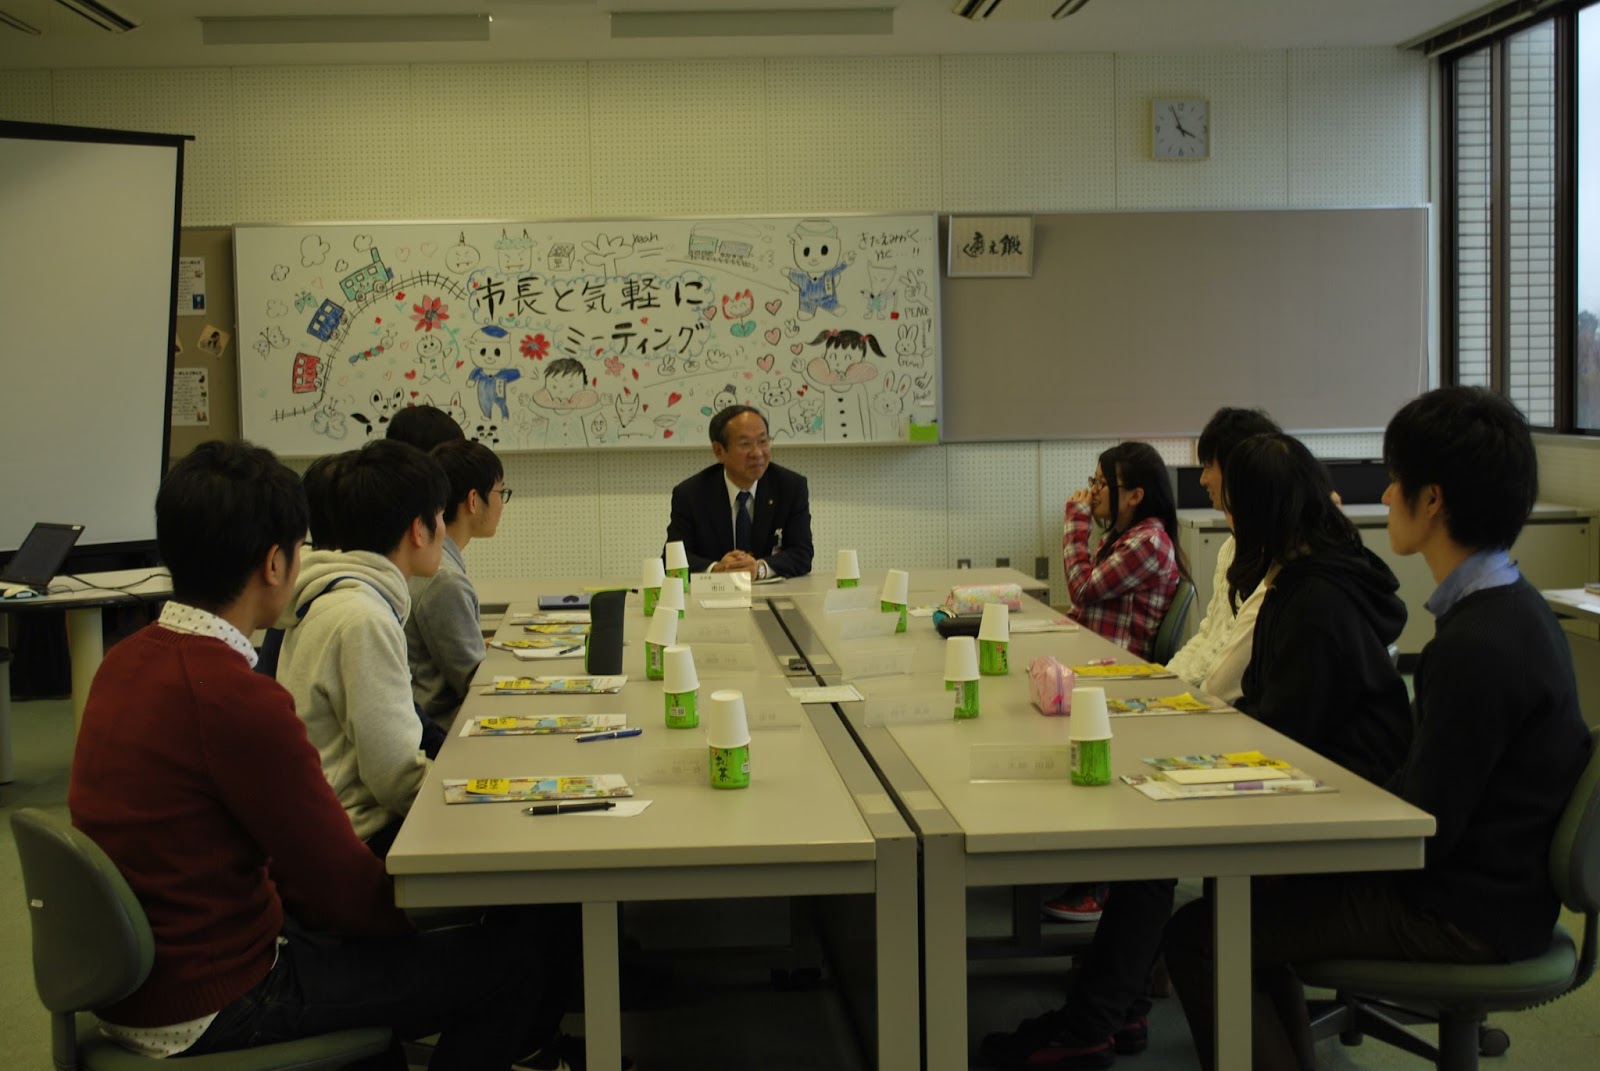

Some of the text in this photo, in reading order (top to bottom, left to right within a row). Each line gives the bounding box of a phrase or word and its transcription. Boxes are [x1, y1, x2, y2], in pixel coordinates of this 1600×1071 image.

[475, 276, 703, 322] 市長と気軽に
[563, 322, 704, 356] ミーティング
